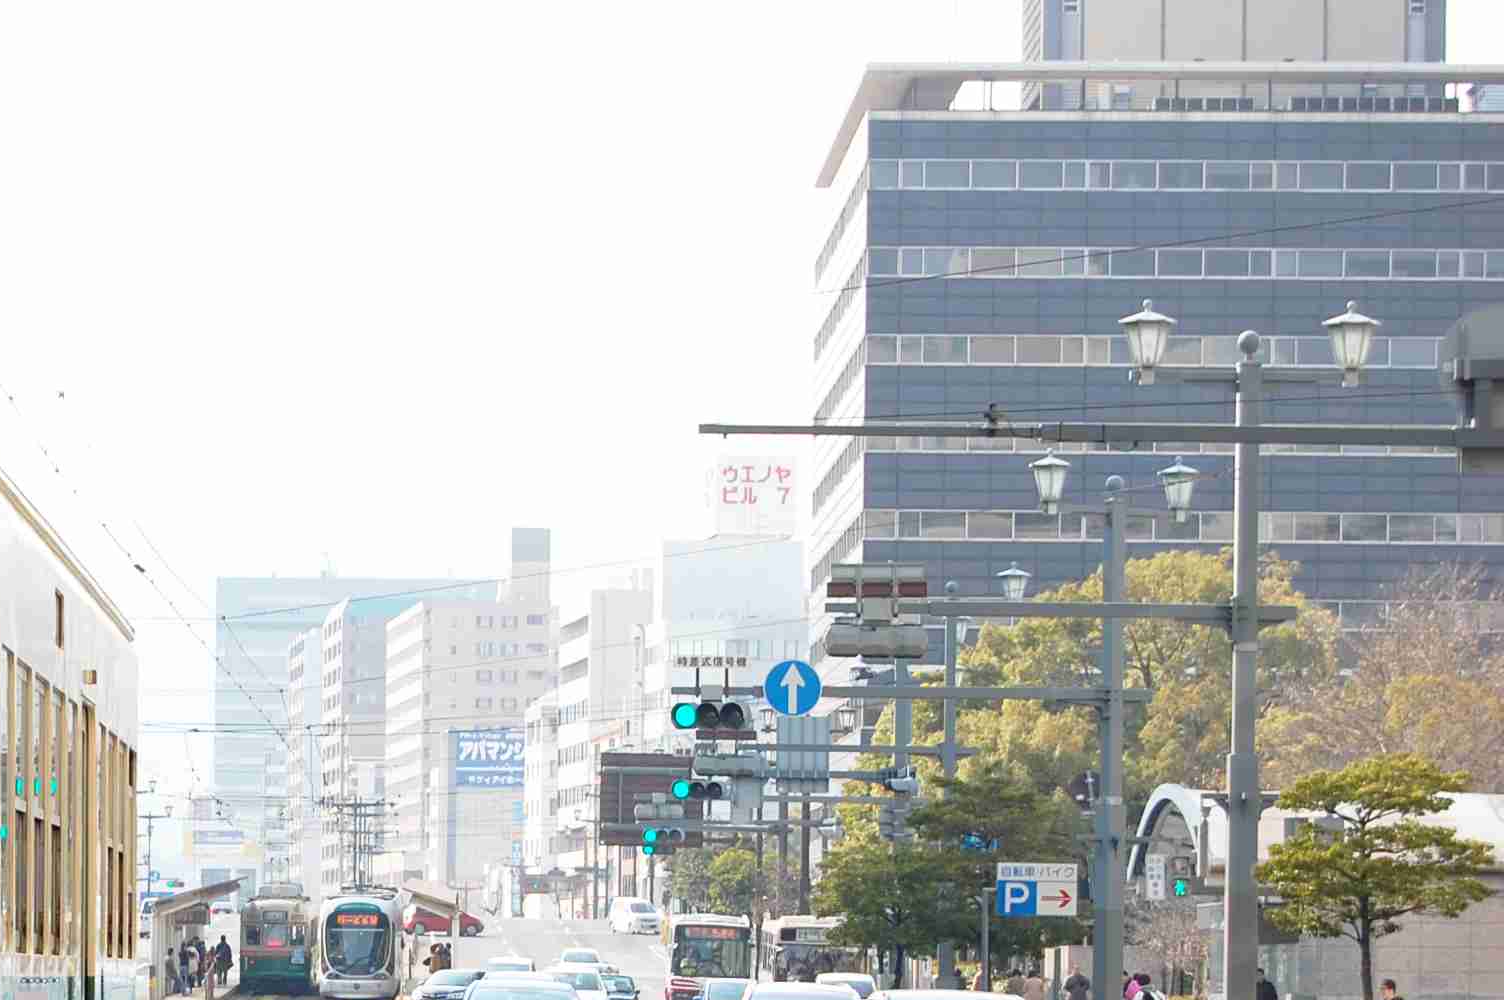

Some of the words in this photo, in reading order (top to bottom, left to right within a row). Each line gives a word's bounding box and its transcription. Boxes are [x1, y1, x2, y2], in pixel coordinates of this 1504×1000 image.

[722, 465, 791, 484] ウエノヤ
[1004, 882, 1030, 912] P
